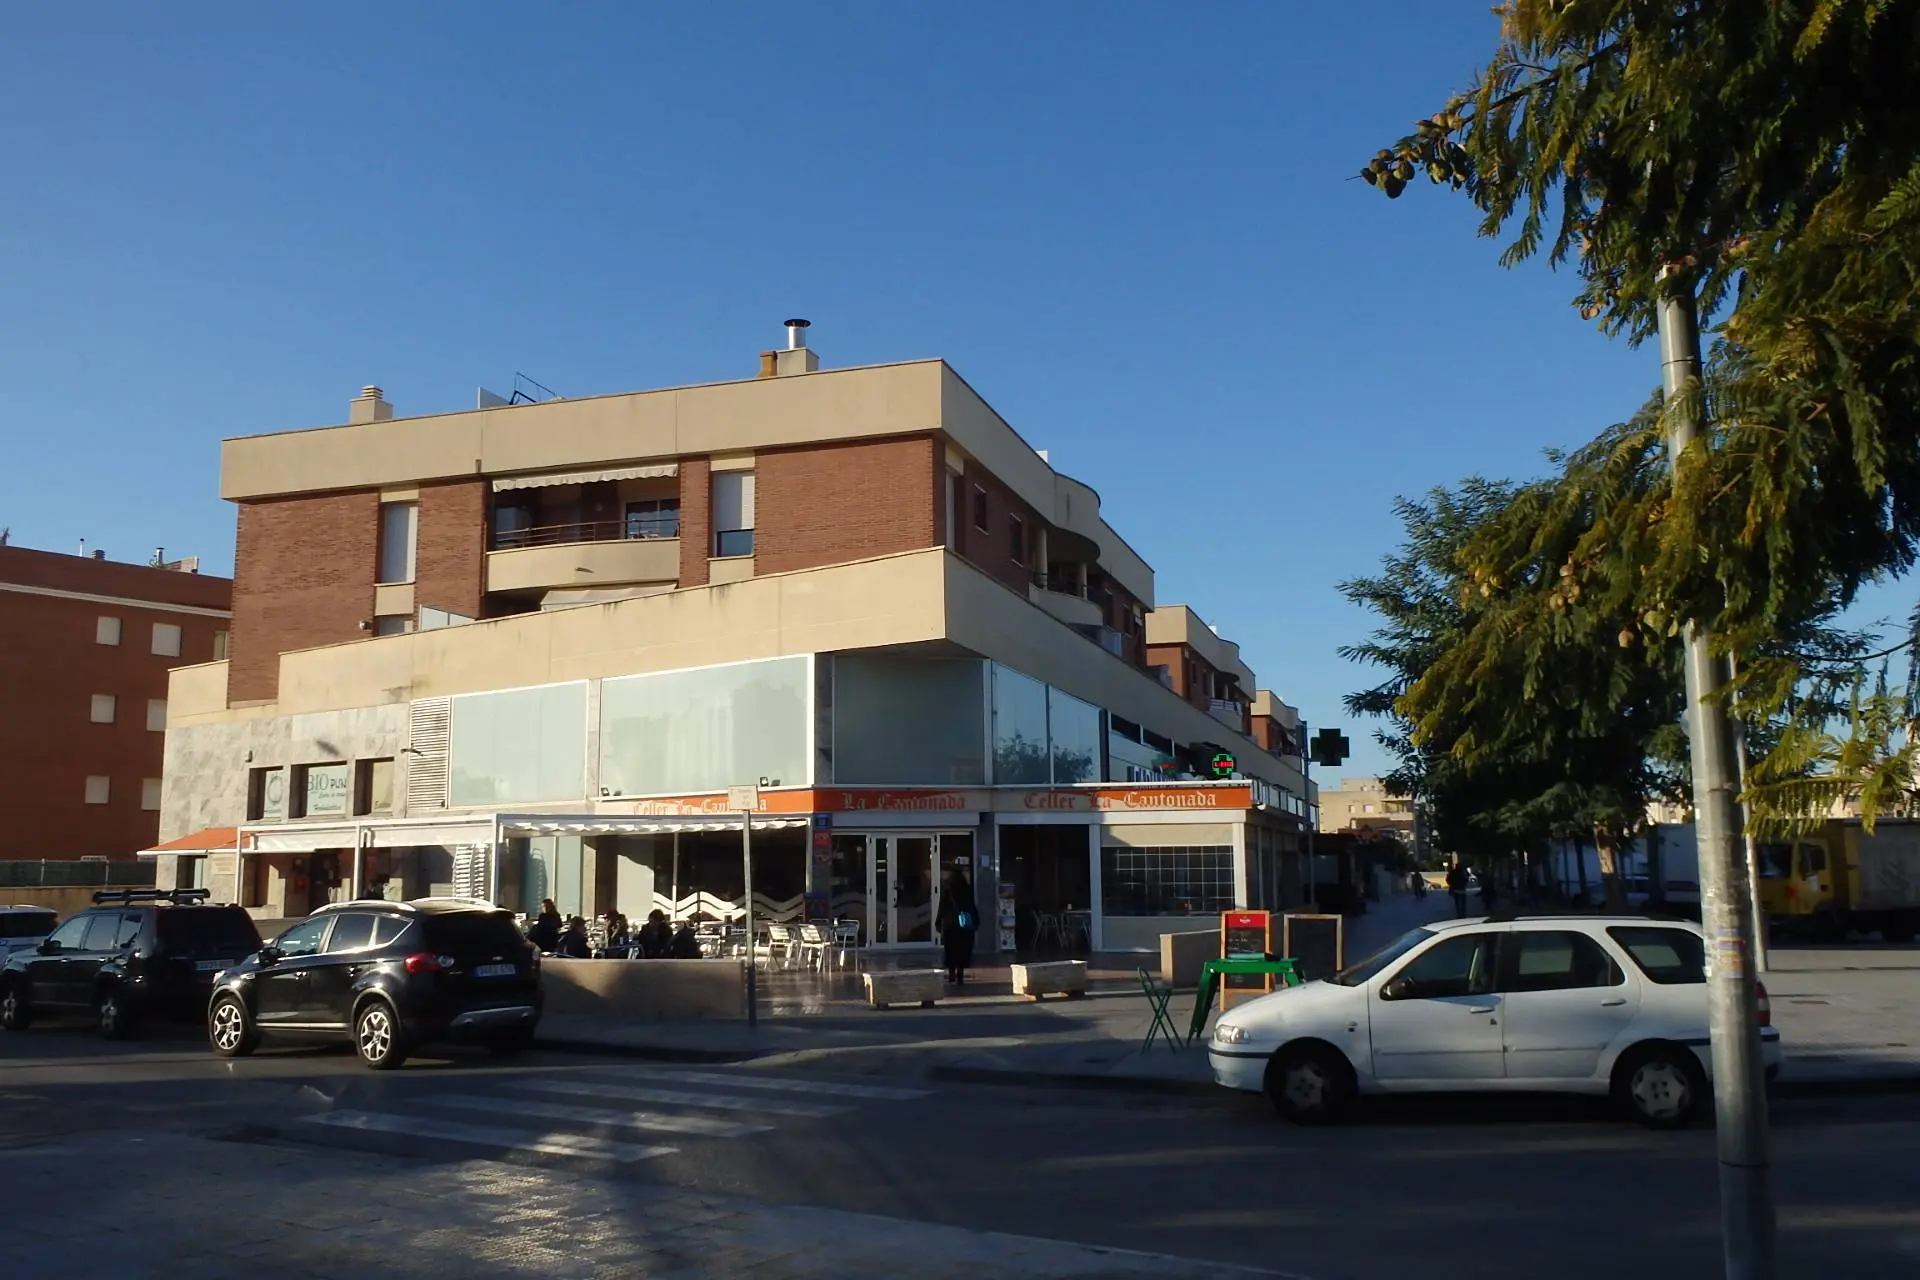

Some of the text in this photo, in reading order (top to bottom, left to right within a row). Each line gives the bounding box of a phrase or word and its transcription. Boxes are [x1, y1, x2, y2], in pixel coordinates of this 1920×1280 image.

[842, 792, 966, 811] La Cantonada
[1024, 790, 1217, 809] Celler La Cantonada
